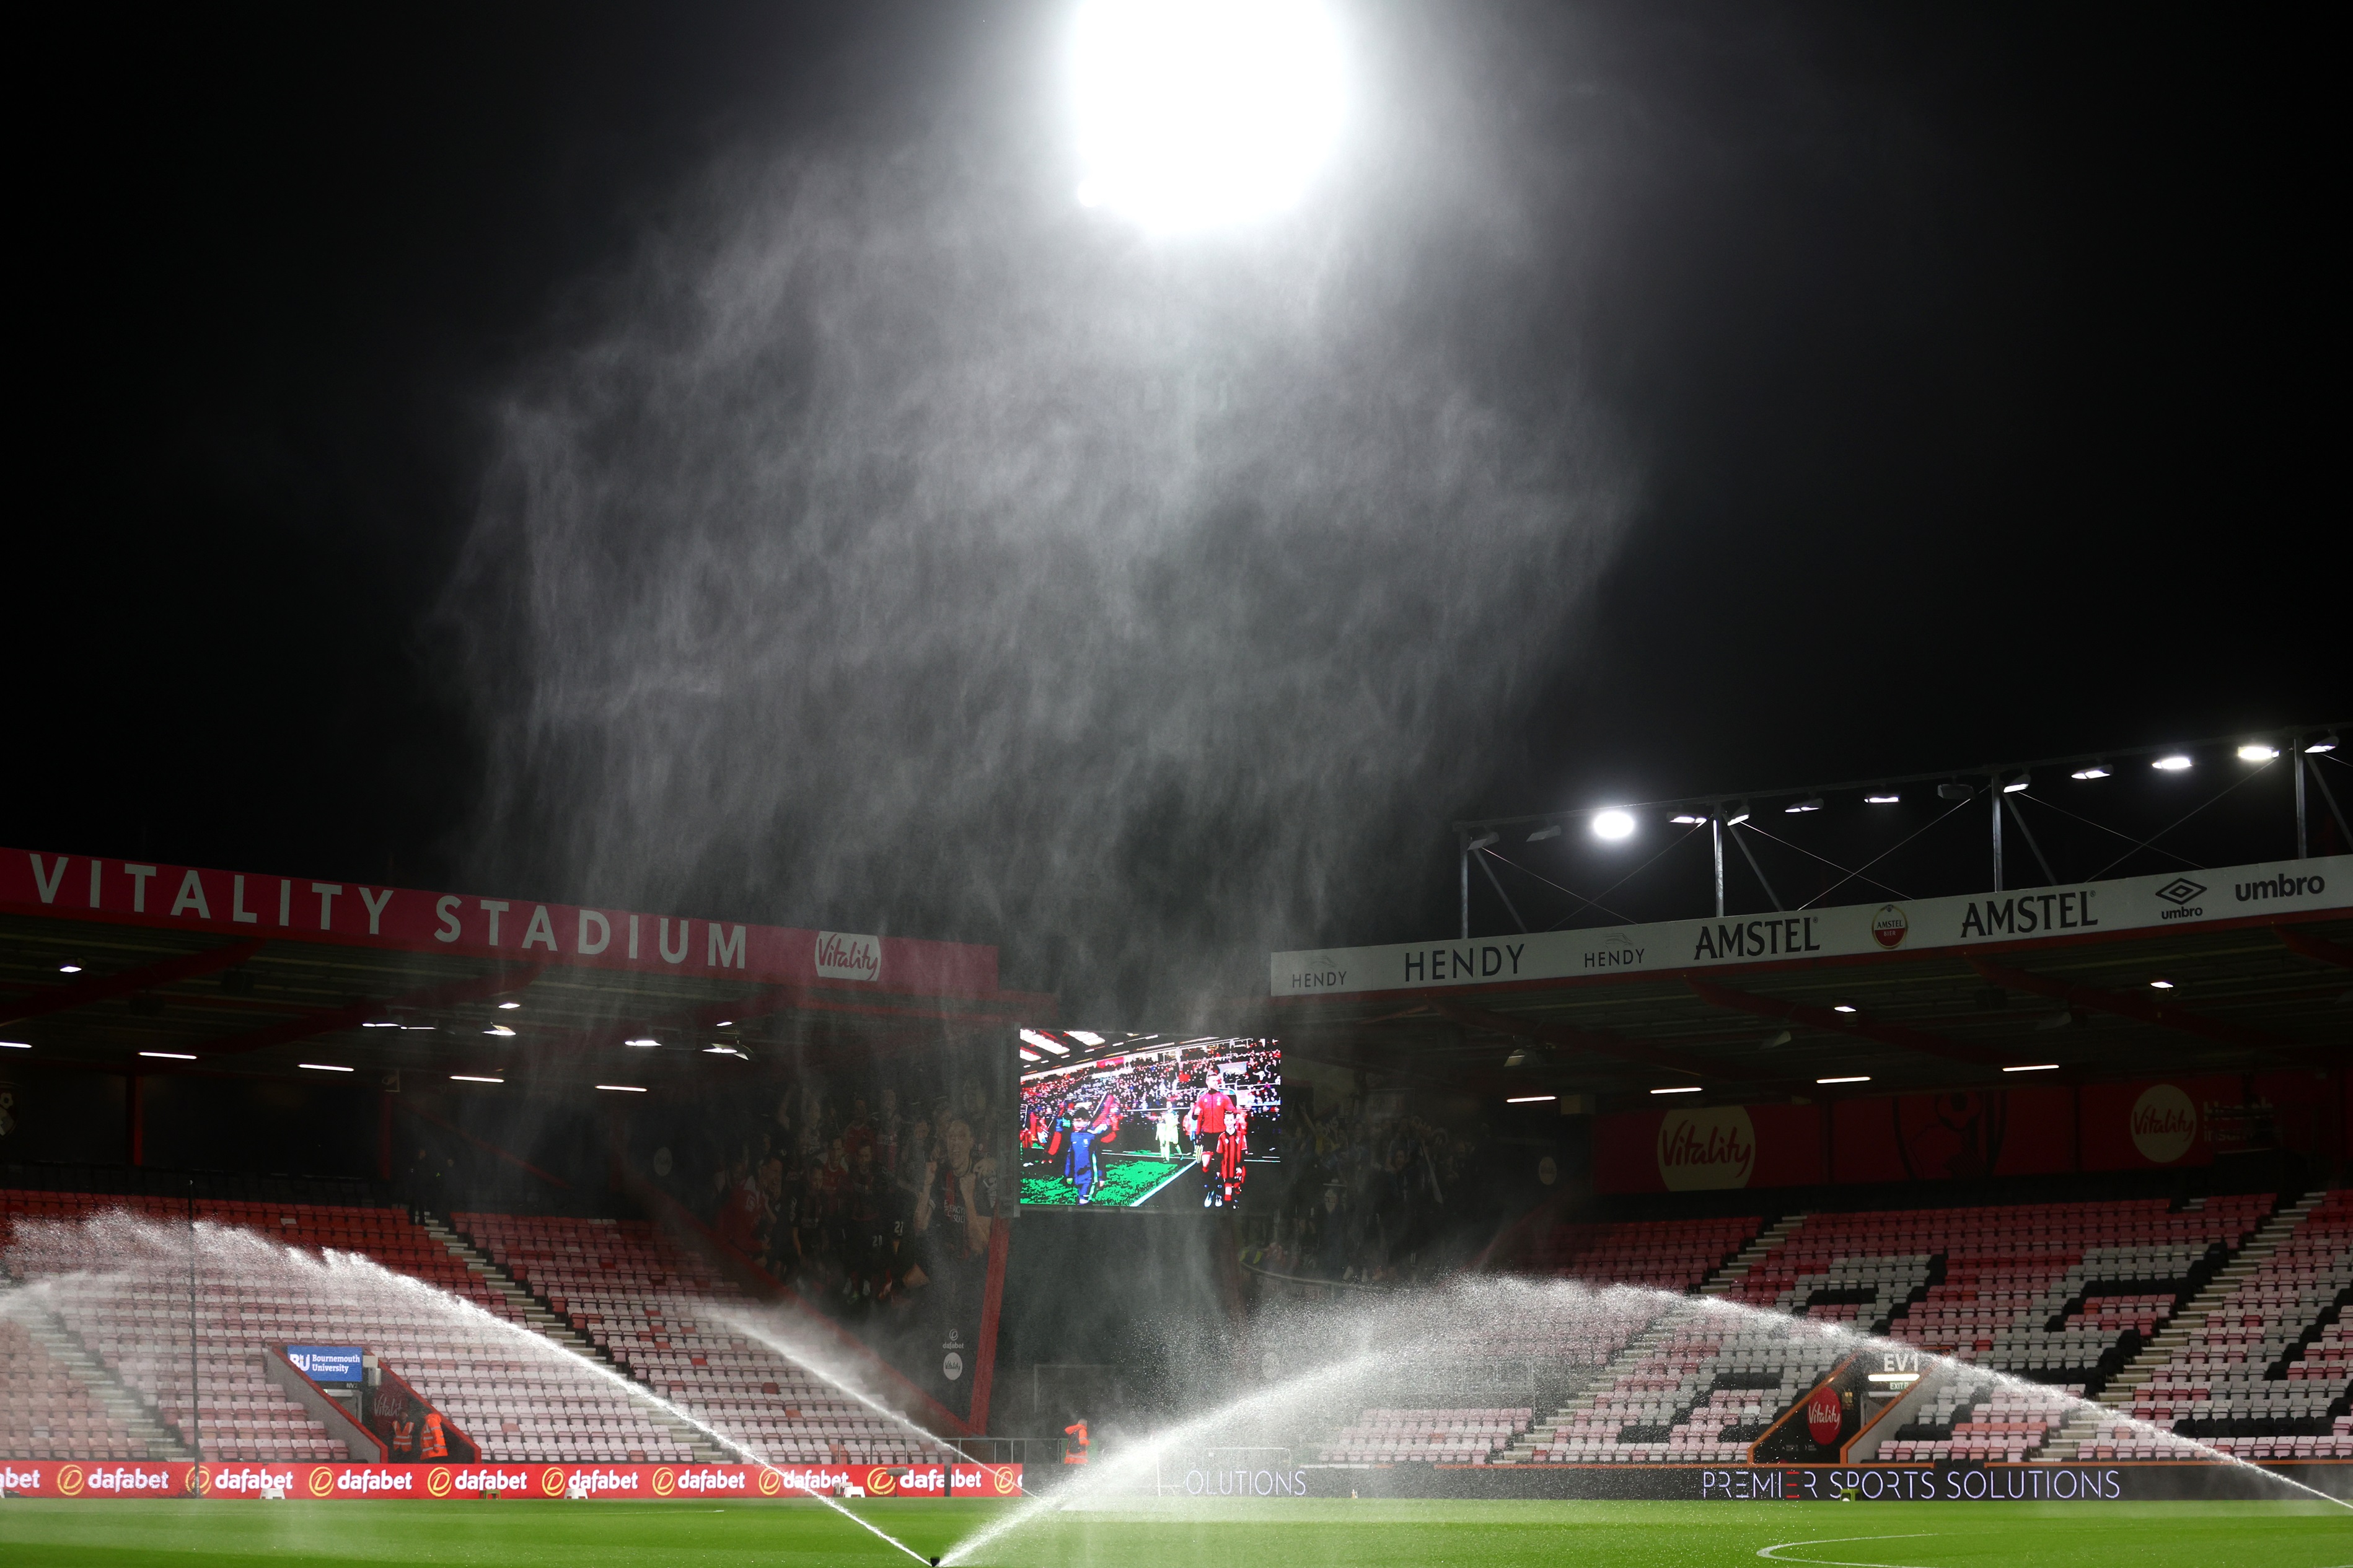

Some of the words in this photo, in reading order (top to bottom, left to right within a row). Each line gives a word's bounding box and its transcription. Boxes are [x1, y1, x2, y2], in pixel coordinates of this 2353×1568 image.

[2235, 874, 2325, 901] umbro
[30, 853, 394, 934] VITALITY
[434, 896, 746, 968] STADIUM
[1961, 891, 2098, 938] AMSTEL
[2162, 906, 2202, 920] umbro
[1877, 920, 1902, 928] AMSTEL
[1694, 916, 1820, 960] AMSTEL
[818, 932, 879, 981] Vitality
[1405, 944, 1524, 982] HENDY
[1585, 948, 1645, 968] HENDY
[1292, 971, 1347, 988] HENDY
[2134, 1105, 2194, 1141] Vitality
[1663, 1119, 1752, 1177] Vitality
[312, 1354, 360, 1362] Bournemouth
[312, 1364, 349, 1373] University
[1884, 1352, 1919, 1372] EV1
[1890, 1382, 1904, 1390] EXIT
[374, 1393, 403, 1417] Vitalit
[1808, 1401, 1841, 1430] Vitality
[88, 1468, 169, 1493] dafabet
[215, 1468, 293, 1493] dafabet
[337, 1469, 412, 1493] dafabet
[455, 1469, 527, 1491] dafabet
[568, 1469, 638, 1493] dafabet
[677, 1469, 745, 1492] dafabet
[1186, 1470, 1306, 1496] OLUTIONS
[1703, 1471, 1818, 1499] PREMIER
[1830, 1471, 1935, 1499] SPORTS
[1946, 1470, 2120, 1499] SOLUTIONS
